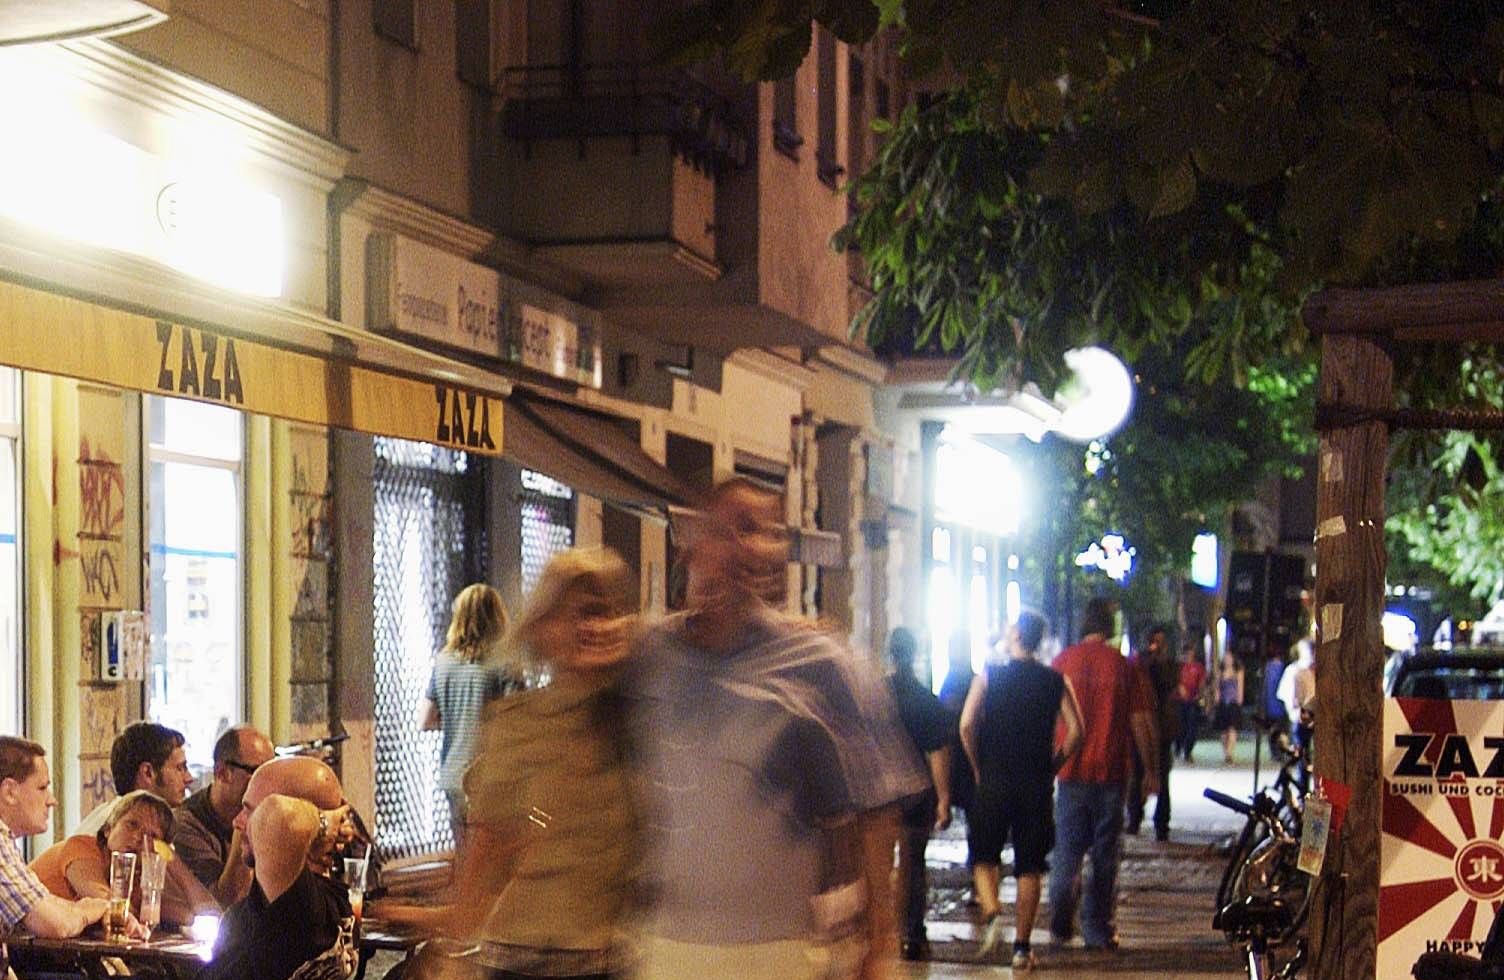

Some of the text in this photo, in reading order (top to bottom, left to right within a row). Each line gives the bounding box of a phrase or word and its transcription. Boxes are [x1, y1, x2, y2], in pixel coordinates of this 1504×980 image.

[155, 321, 244, 404] ZAZA
[435, 384, 495, 450] ZAZA
[1392, 784, 1433, 796] SUSHI
[1438, 784, 1469, 796] UND
[1426, 940, 1485, 953] HAPPY
